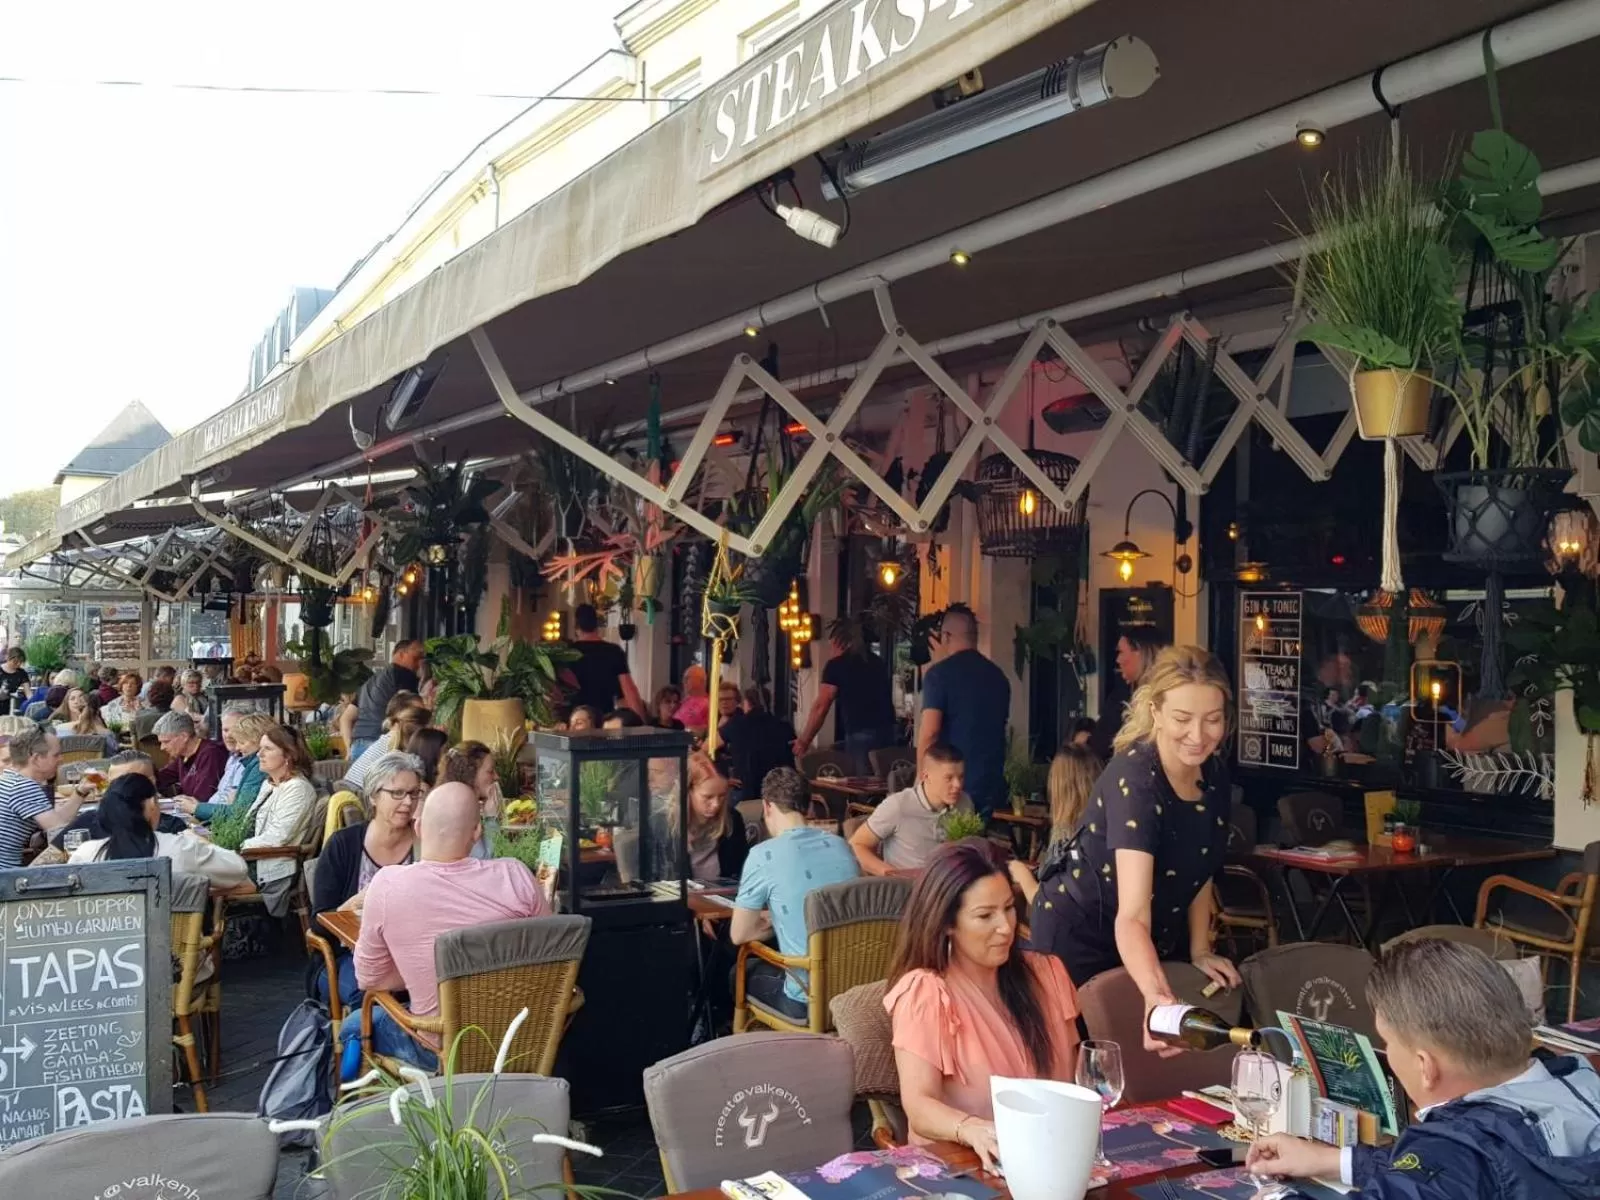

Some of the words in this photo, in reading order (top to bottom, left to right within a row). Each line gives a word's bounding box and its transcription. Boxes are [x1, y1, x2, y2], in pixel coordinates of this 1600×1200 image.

[1273, 600, 1299, 614] TONIC
[1271, 743, 1293, 758] TAPAS
[9, 943, 144, 999] TAPAS
[44, 1021, 122, 1042] ZEETONG
[123, 1061, 144, 1076] DAY
[2, 1107, 51, 1124] NACHOS
[57, 1086, 146, 1129] PASTA
